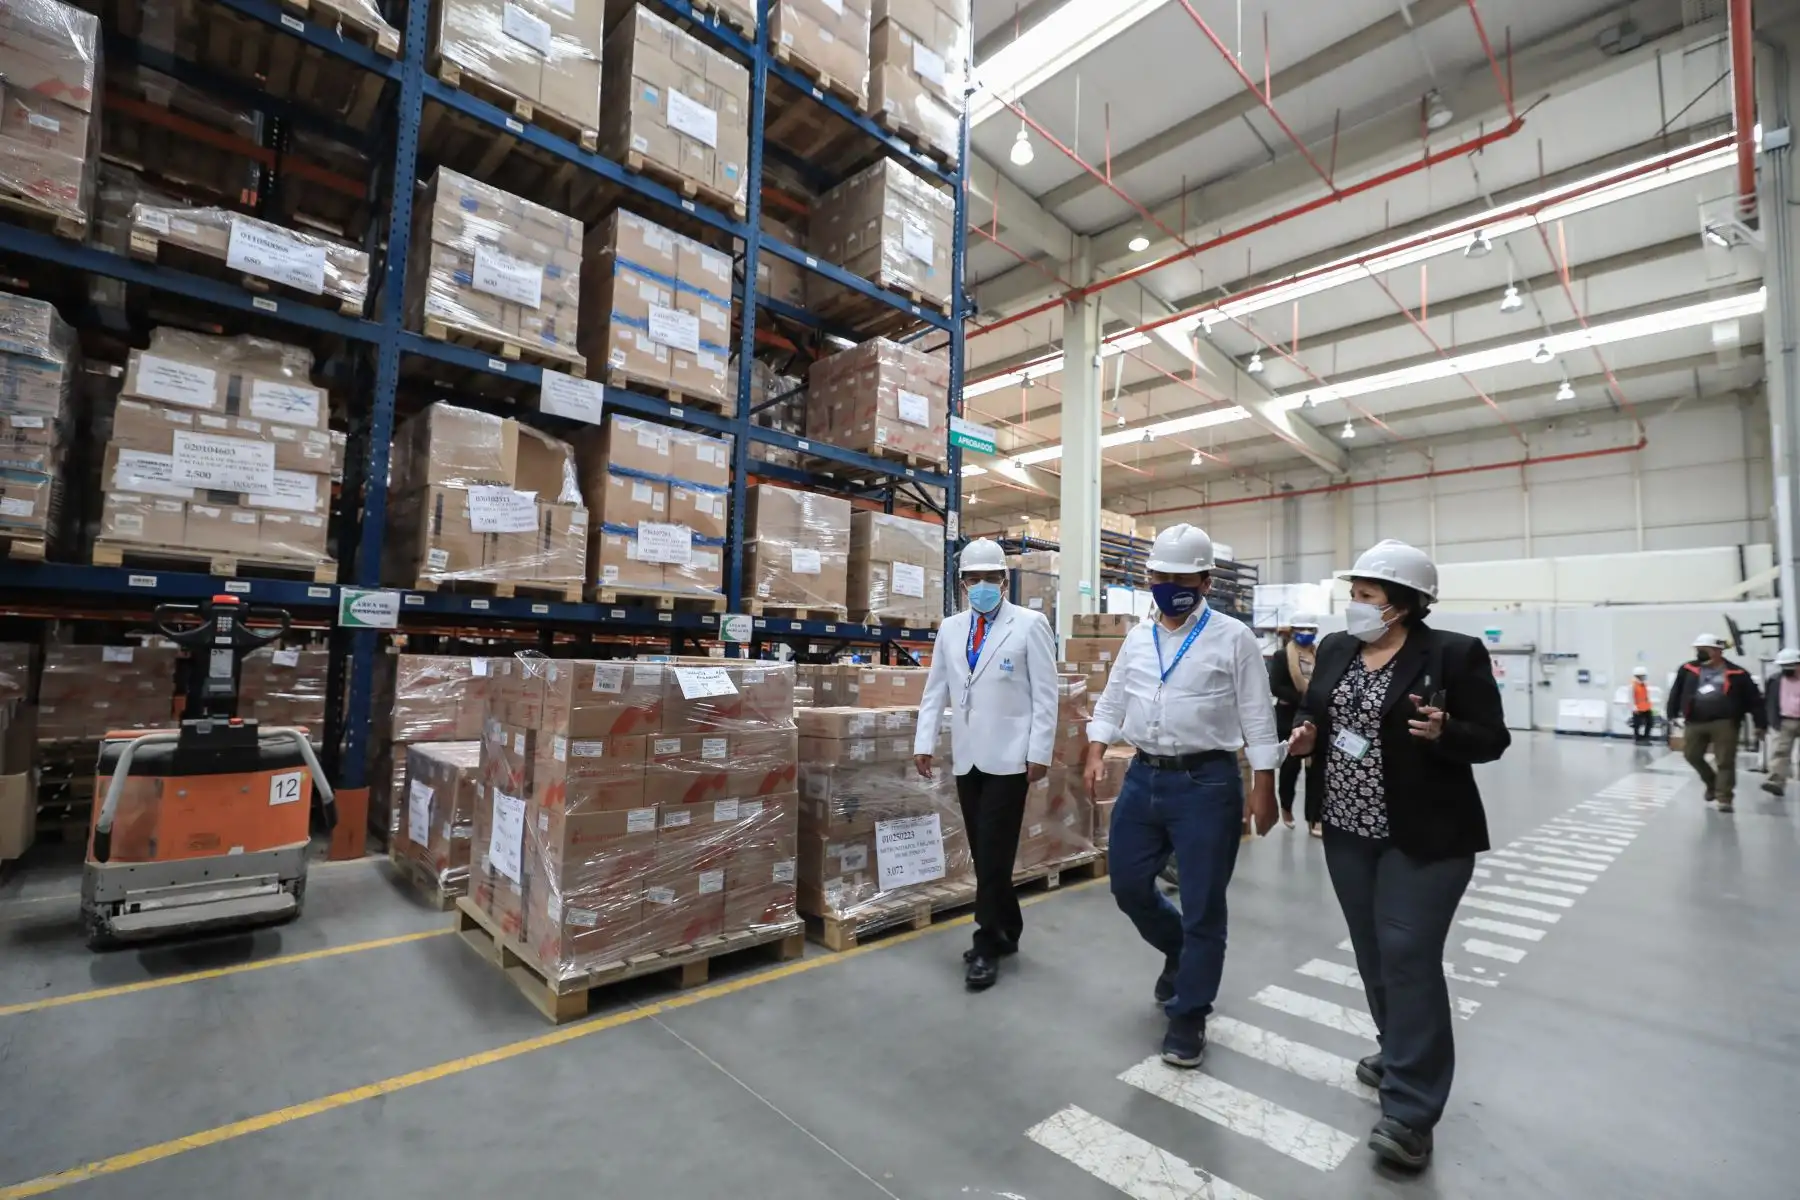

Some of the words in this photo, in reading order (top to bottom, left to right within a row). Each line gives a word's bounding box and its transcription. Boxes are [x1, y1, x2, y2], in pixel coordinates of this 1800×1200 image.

[957, 435, 993, 453] APROBADOS
[275, 778, 297, 799] 12
[881, 830, 915, 844] 010250223
[886, 865, 904, 876] 3,072
